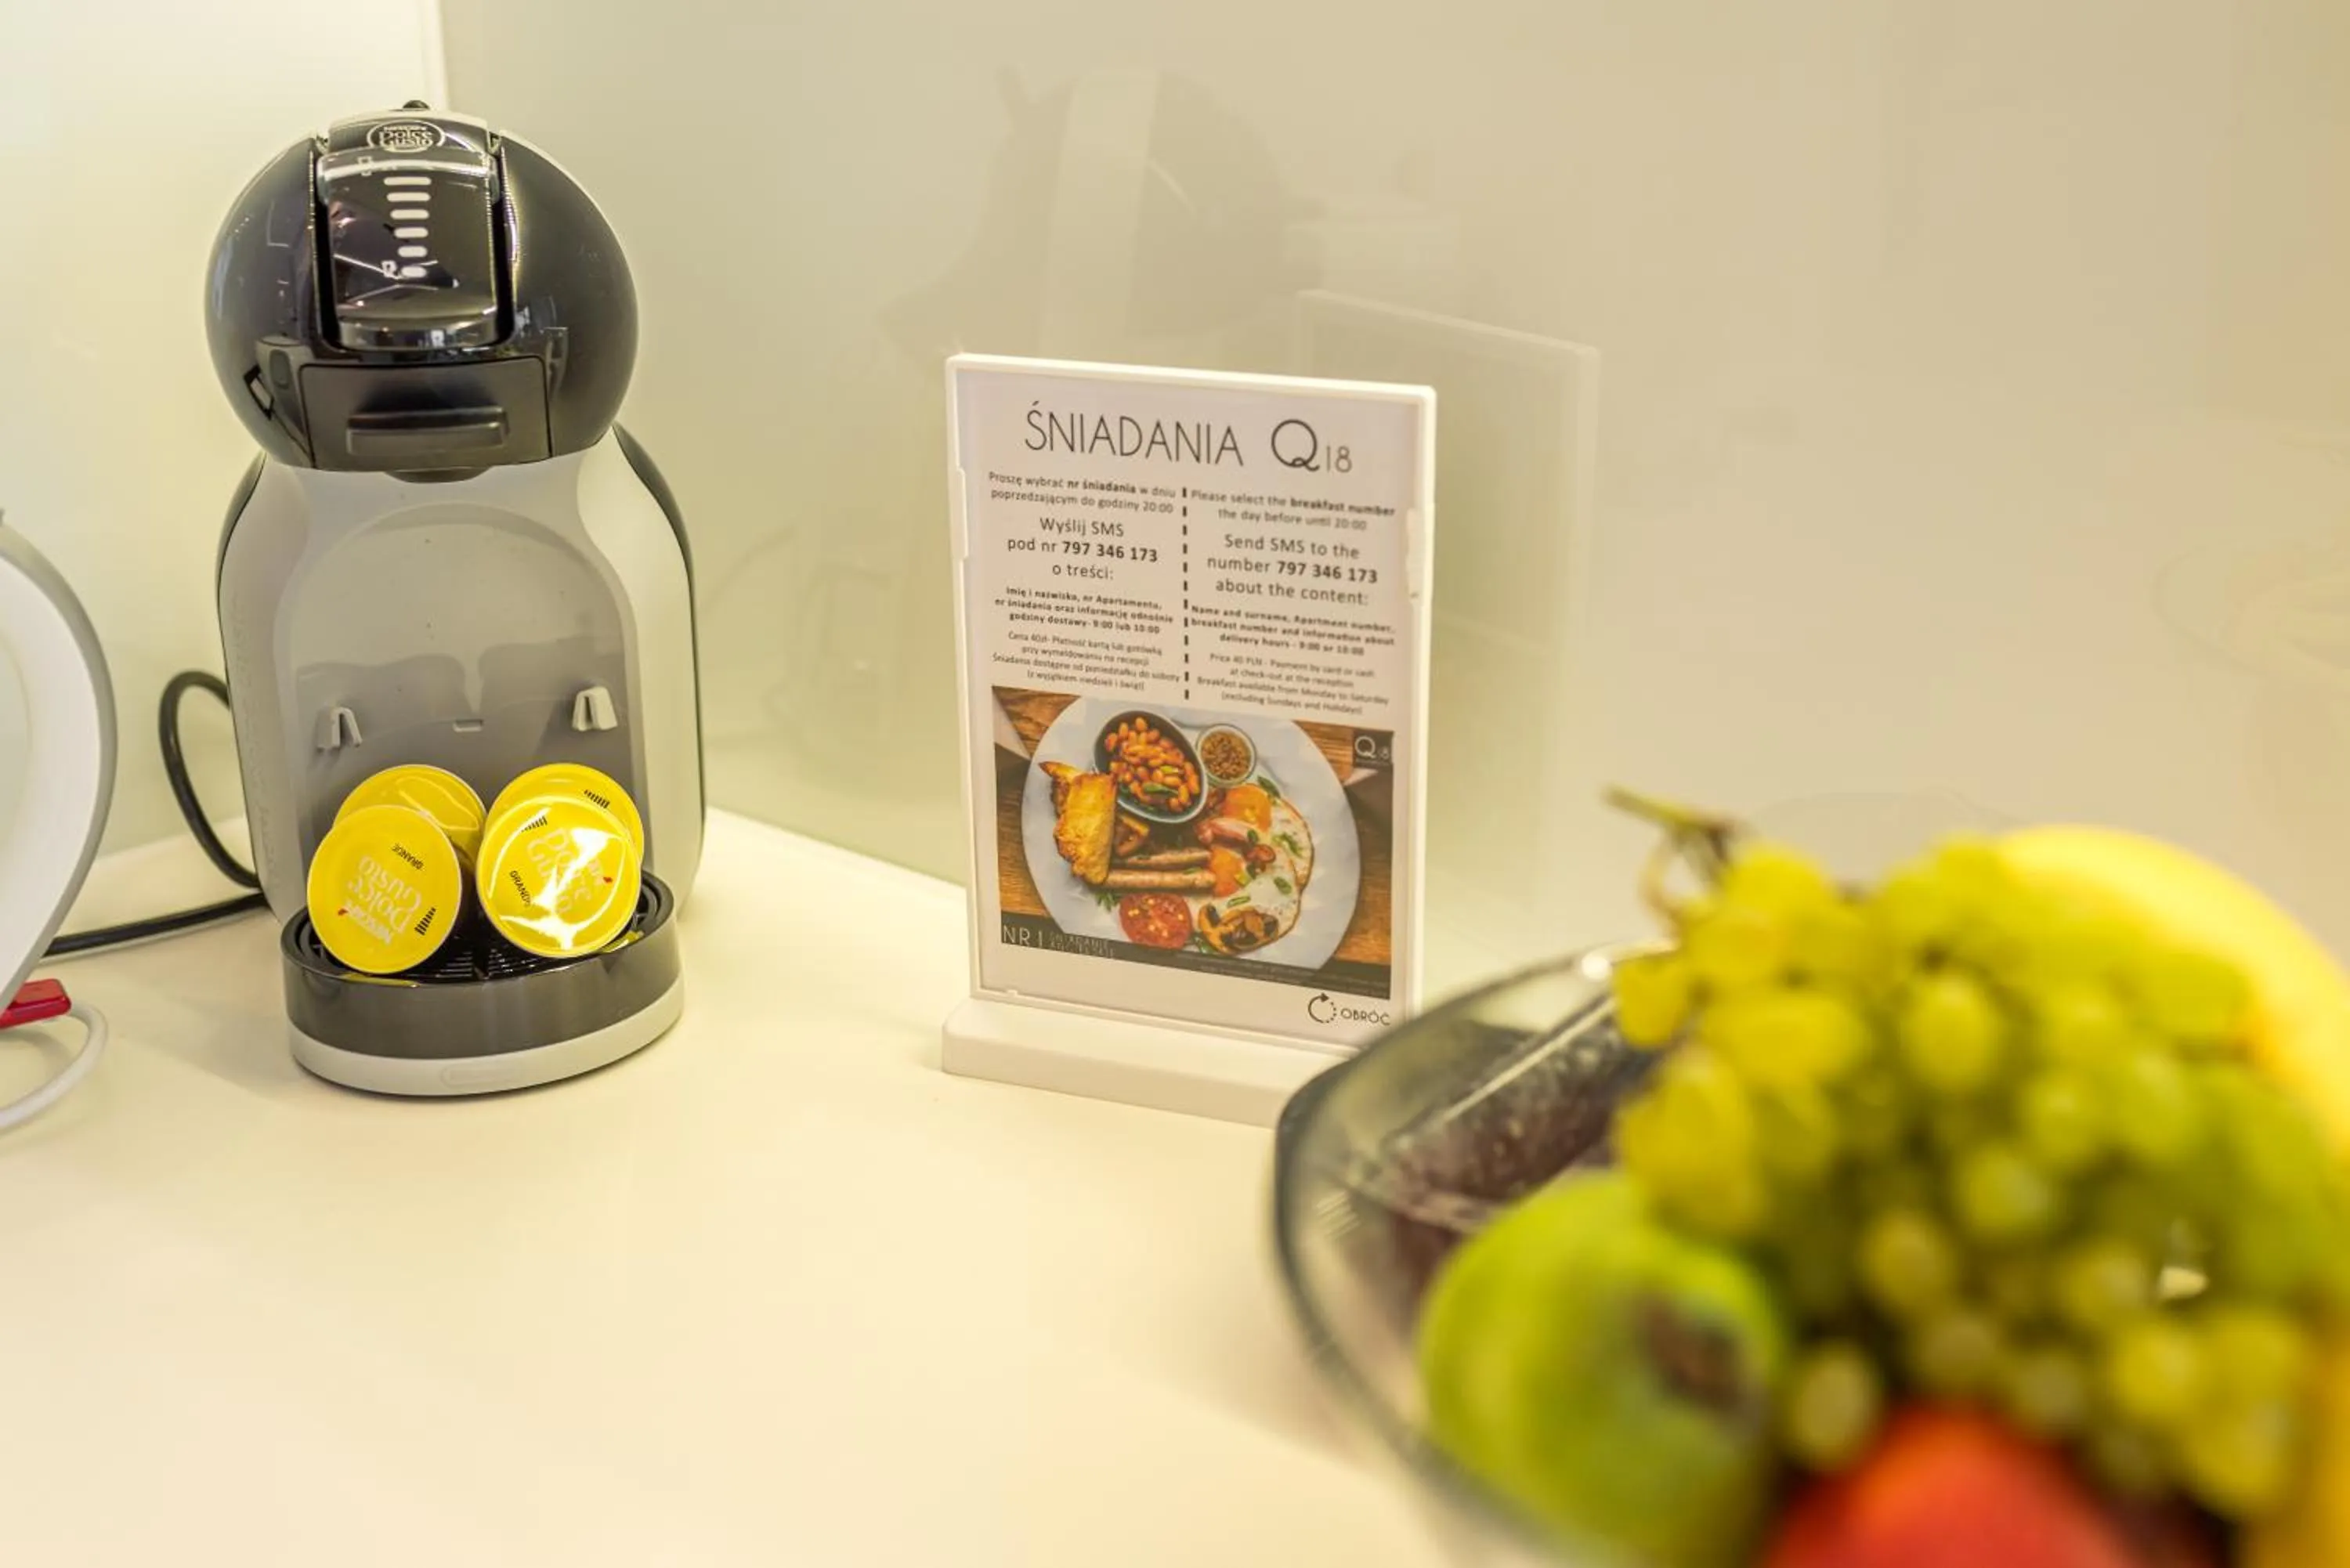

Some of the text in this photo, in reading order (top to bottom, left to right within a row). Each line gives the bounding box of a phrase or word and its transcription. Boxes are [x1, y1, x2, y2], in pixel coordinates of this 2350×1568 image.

[1025, 400, 1244, 467] ŚNIADANIA
[989, 471, 1176, 498] Proszę wybrać nr śniadania w dniu
[991, 489, 1173, 514] poprzedzającym do godziny 20:00
[1191, 489, 1396, 517] Please select the breakfast number
[1039, 517, 1125, 538] Wyślij SMS
[1217, 508, 1367, 531] the day before until 20:00
[1007, 538, 1158, 562] pod nr 797 346 173
[1224, 533, 1360, 559] Send SMS to the
[1051, 563, 1115, 581] o treści:
[1207, 556, 1378, 584] number 797 346 173
[1006, 586, 1026, 598] Imię
[1035, 590, 1080, 602] nazwiska,
[1215, 578, 1369, 607] about the content:
[1007, 598, 1052, 611] śniadania
[1054, 605, 1075, 613] oraz
[1077, 605, 1127, 620] informację
[1130, 612, 1173, 623] odnośnie
[1008, 612, 1046, 624] godziny
[1191, 605, 1220, 616] Name
[1223, 609, 1242, 619] and
[1245, 612, 1292, 623] surname,
[1294, 615, 1348, 630] Apartment
[1191, 617, 1395, 646] breakfast number and information about
[1220, 633, 1260, 647] delivery
[1262, 637, 1290, 649] hours
[1003, 924, 1031, 946] NR
